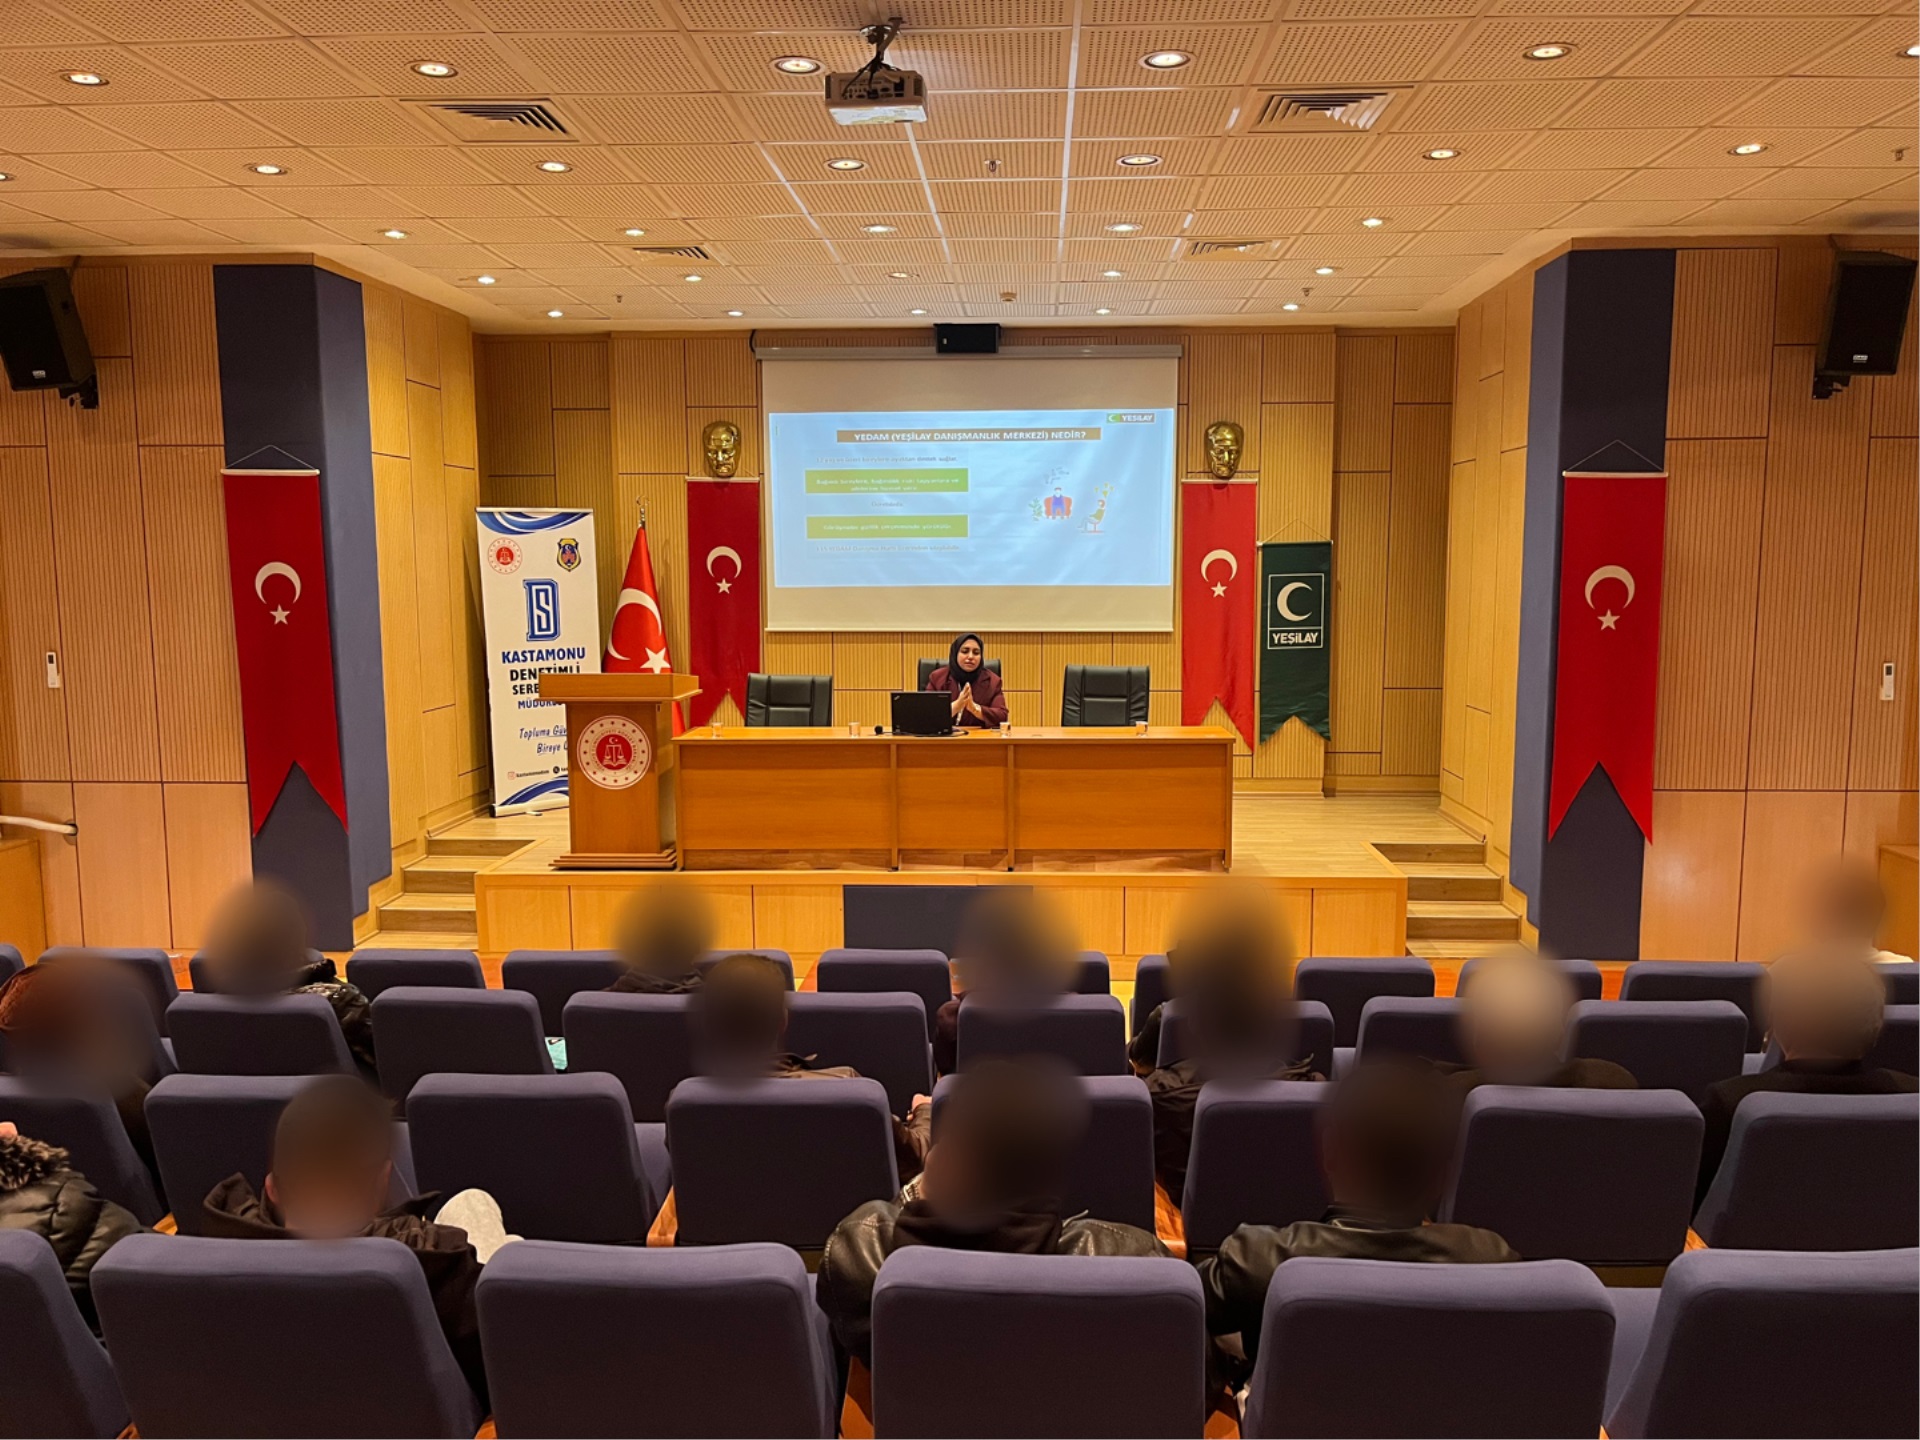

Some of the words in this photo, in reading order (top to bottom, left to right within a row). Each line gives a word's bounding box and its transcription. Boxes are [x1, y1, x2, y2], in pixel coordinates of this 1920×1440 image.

[854, 433, 889, 441] YEDAM
[891, 432, 931, 442] (YEŞİLAY
[934, 431, 1000, 441] DANIŞMANLIK
[1003, 429, 1049, 440] MERKEZİ)
[1051, 429, 1086, 439] NEDİR?
[1272, 632, 1318, 645] YEŞİLAY
[501, 647, 586, 664] KASTAMONU
